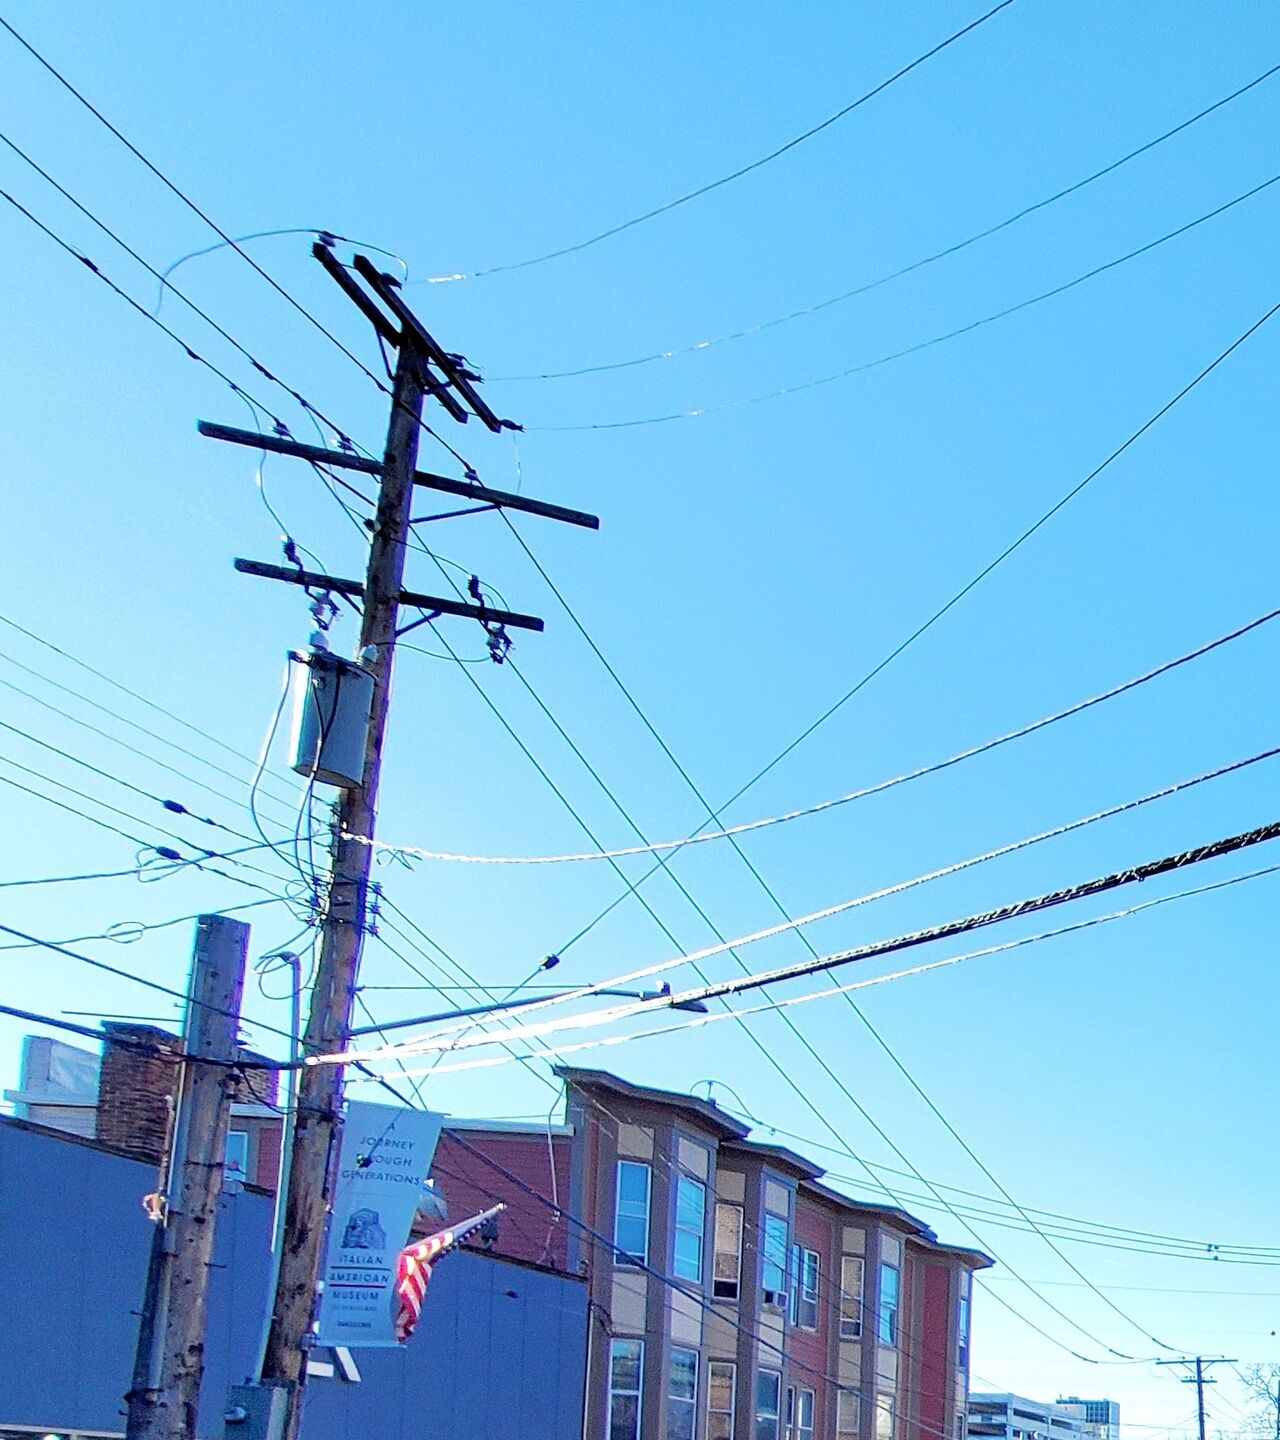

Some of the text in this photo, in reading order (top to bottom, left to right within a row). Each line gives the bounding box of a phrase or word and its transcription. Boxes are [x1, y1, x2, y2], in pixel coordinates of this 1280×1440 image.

[387, 1122, 395, 1131] A
[341, 1169, 420, 1185] GENERATIONS
[339, 1254, 383, 1264] ITALIAN
[329, 1272, 389, 1282] AMERICAN
[333, 1290, 380, 1300] MUSEUM
